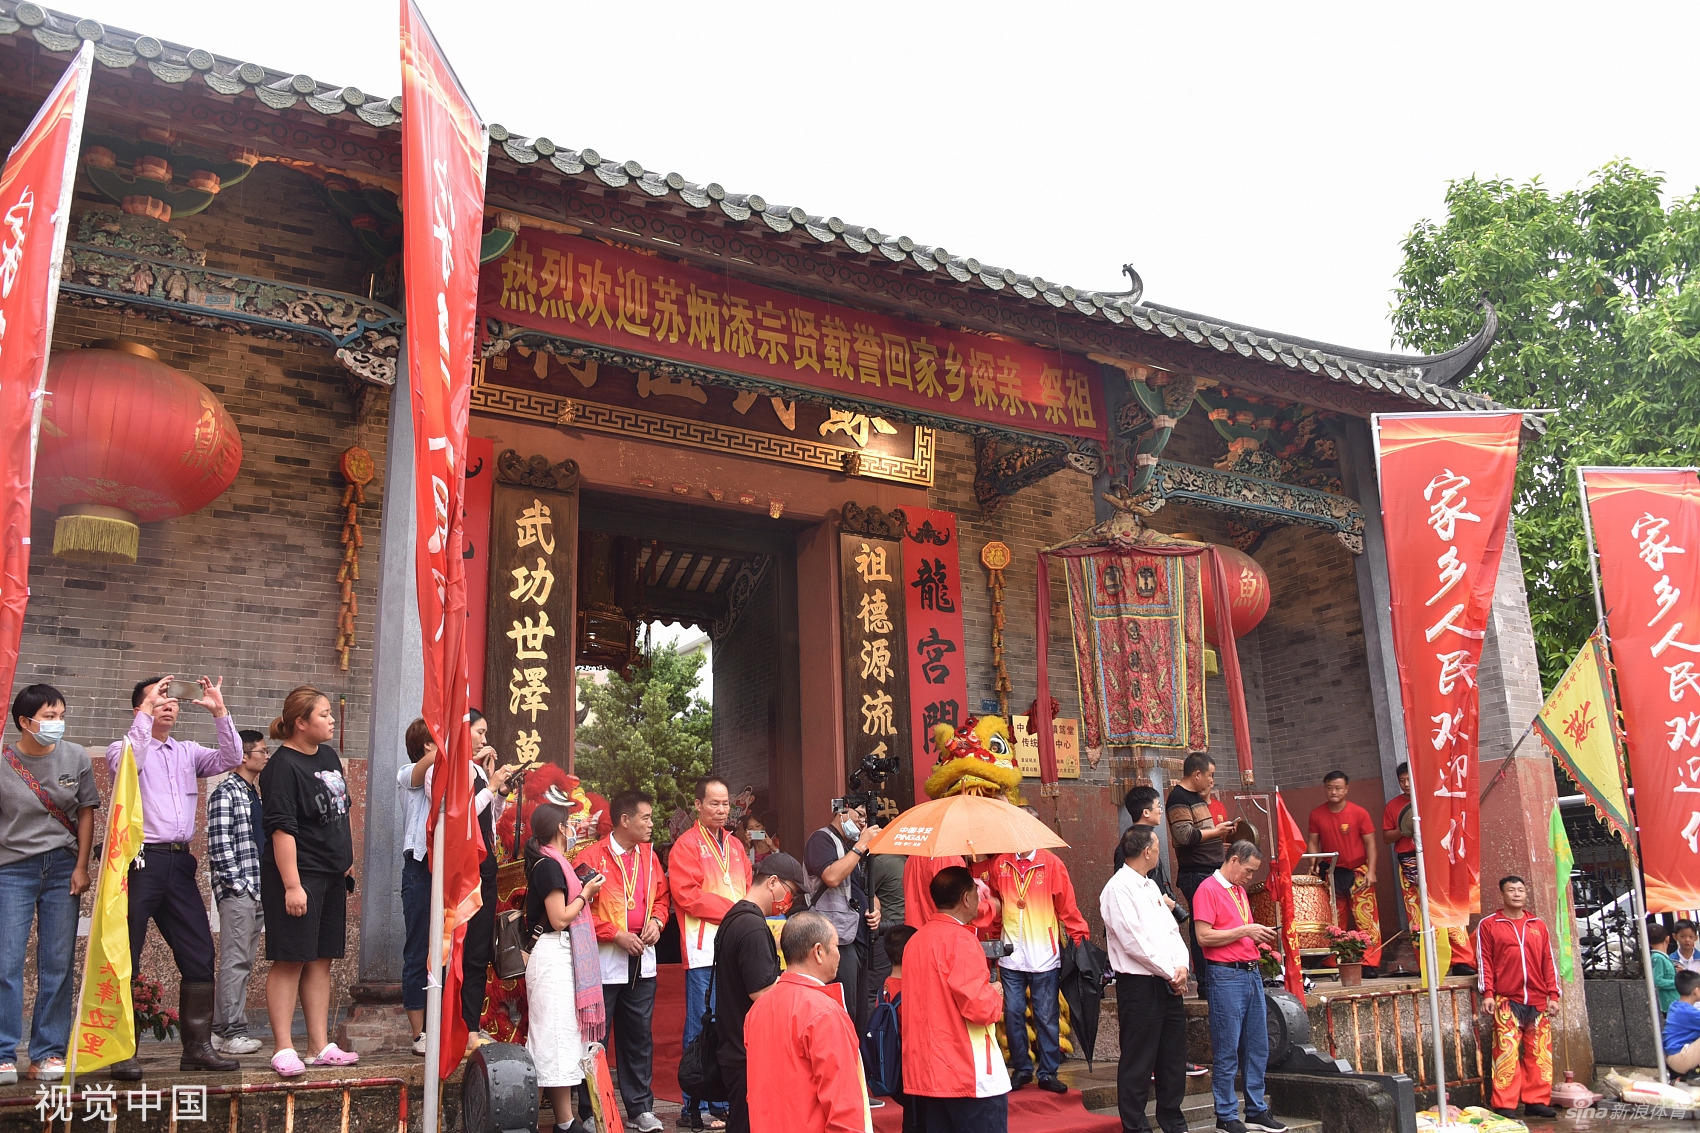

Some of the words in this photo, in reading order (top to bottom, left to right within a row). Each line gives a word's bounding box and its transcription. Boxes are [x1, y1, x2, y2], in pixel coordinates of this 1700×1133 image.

[500, 239, 1097, 429] 热烈欢迎苏炳添宗贤载誉回家乡探亲、祭祖
[854, 543, 899, 820] 祖德源流
[894, 833, 928, 842] PINGAN
